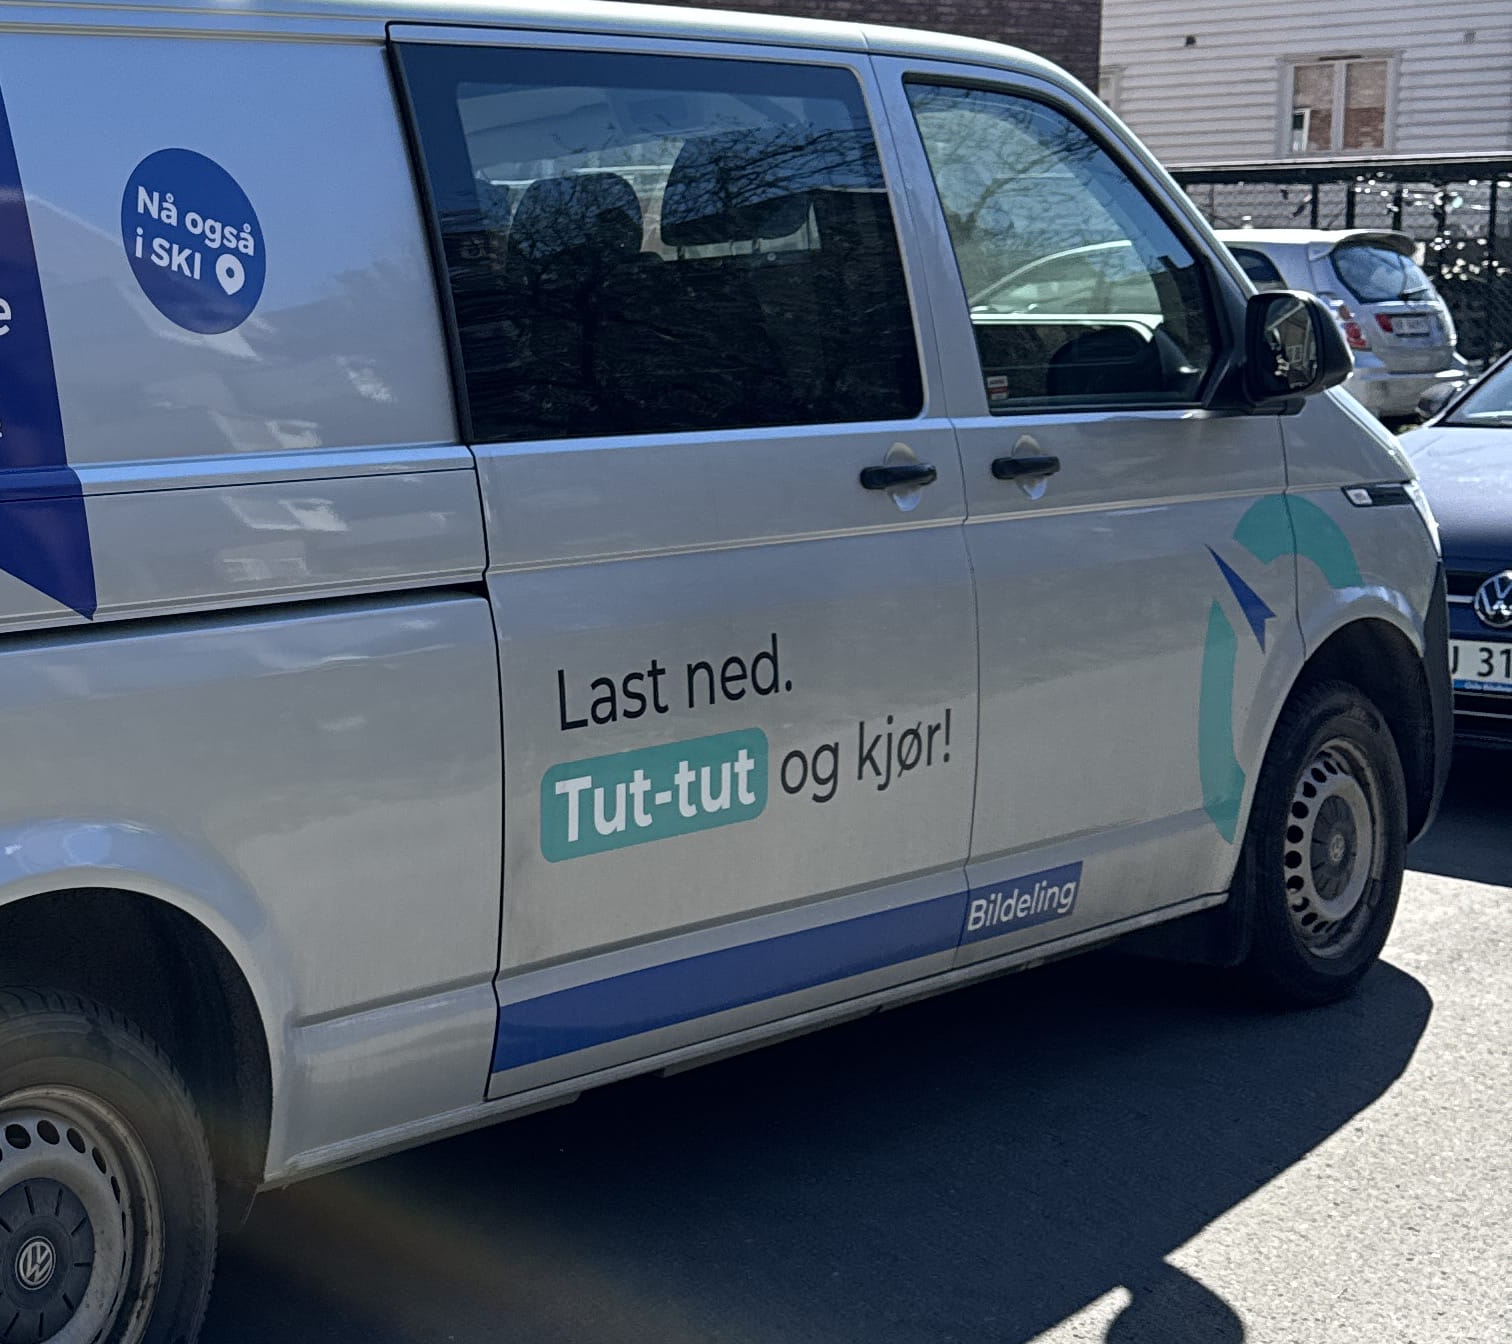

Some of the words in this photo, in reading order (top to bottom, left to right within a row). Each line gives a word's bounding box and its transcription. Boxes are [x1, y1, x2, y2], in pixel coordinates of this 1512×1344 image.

[137, 186, 178, 227] Nå
[185, 212, 255, 256] også
[135, 227, 144, 259] i
[150, 237, 202, 280] SKI
[557, 659, 670, 732] Last
[686, 632, 793, 709] ned.
[1476, 647, 1512, 679] 31
[555, 749, 756, 842] Tut-tut
[780, 741, 840, 803] og
[857, 708, 951, 792] kjør!
[967, 880, 1076, 931] Bildeling
